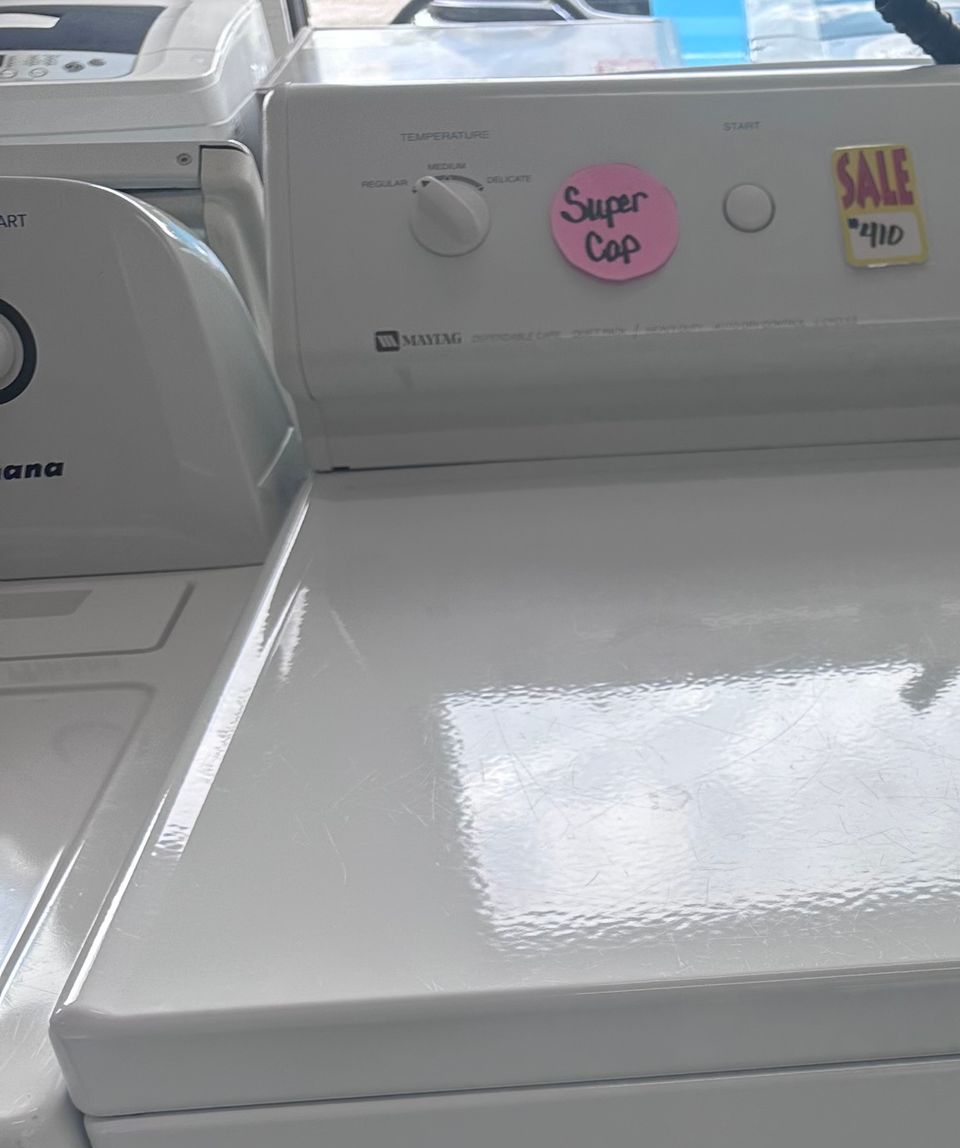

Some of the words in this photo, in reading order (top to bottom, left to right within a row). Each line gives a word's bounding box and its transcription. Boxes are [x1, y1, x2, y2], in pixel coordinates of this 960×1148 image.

[723, 121, 760, 132] START
[400, 130, 490, 142] TEMPERATURE
[427, 162, 467, 171] MEDIUM
[361, 179, 408, 189] REGULAR
[486, 175, 532, 184] DELICATE
[837, 148, 914, 209] SALE
[560, 186, 649, 228] Super
[585, 230, 642, 264] Cap
[401, 332, 462, 347] MAYTAG
[0, 462, 64, 480] ana
